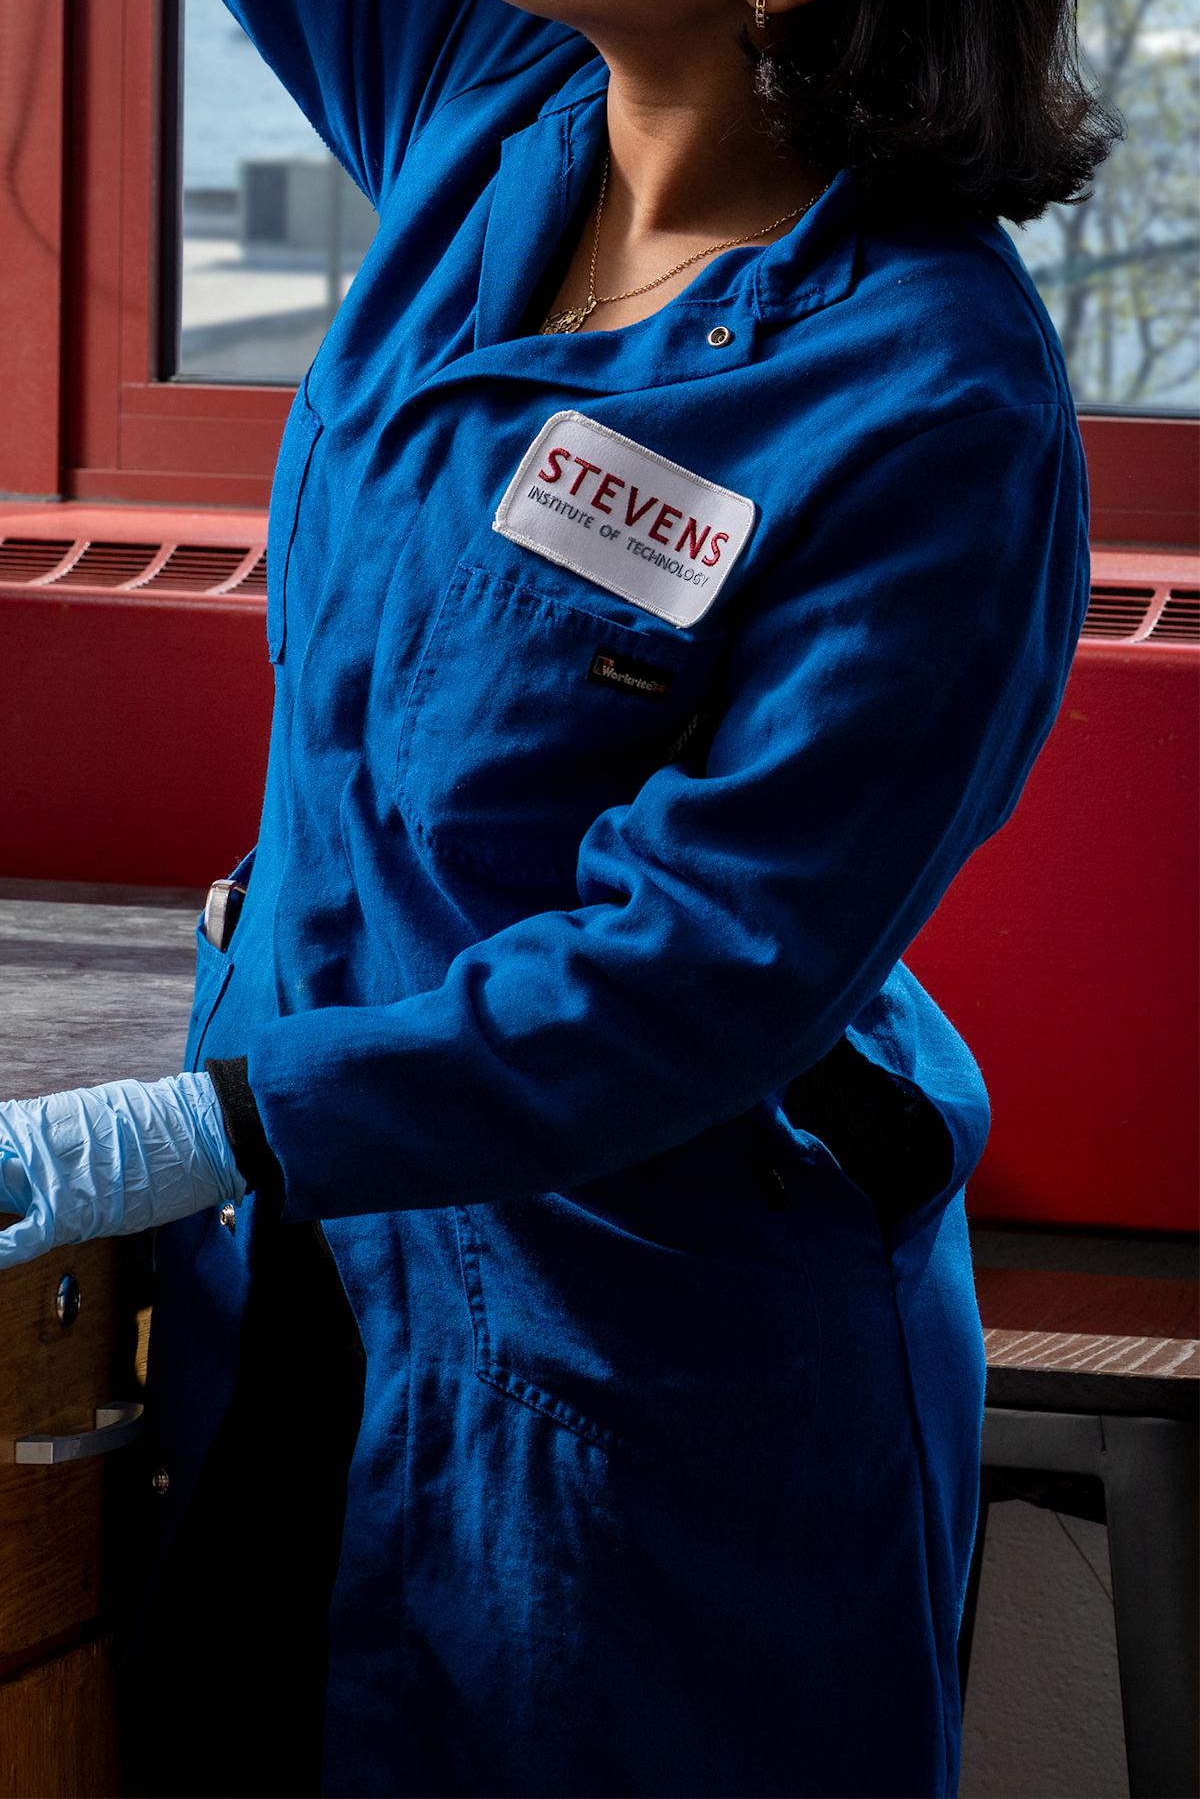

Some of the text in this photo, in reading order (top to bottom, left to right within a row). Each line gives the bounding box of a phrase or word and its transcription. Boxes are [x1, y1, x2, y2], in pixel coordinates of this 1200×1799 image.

[527, 485, 710, 588] INSTITUTE OF TECHNOLOGY
[538, 447, 729, 567] STEVENS
